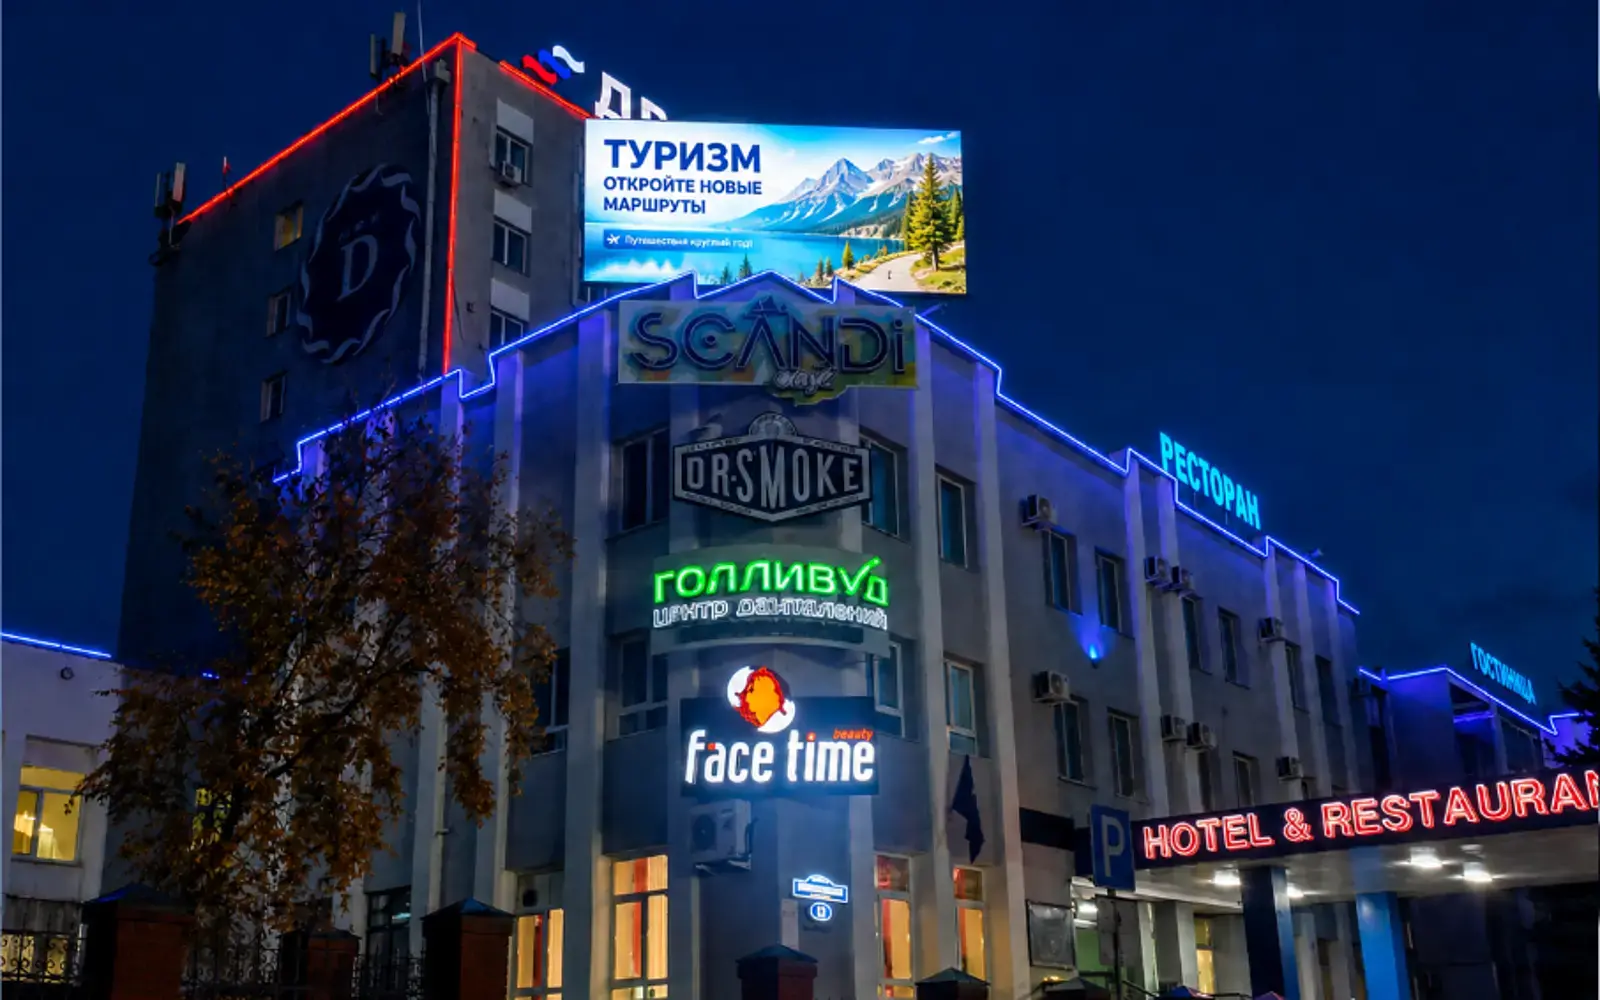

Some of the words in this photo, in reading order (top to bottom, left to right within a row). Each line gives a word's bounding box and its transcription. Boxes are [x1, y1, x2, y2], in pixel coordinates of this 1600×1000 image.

[603, 139, 761, 173] ТУРИЗМ
[603, 175, 697, 194] ОТКРОЙТЕ
[699, 179, 762, 195] НОВЫЕ
[603, 197, 706, 215] МАРШРУТЫ
[1159, 432, 1261, 530] РЕСТОРАН
[1470, 642, 1537, 706] ГОСТИНИЦА
[685, 729, 774, 784] face
[786, 729, 875, 783] time
[832, 727, 874, 742] beauty
[1101, 814, 1125, 878] P
[1141, 813, 1275, 860] HOTEL
[1282, 806, 1314, 842] &
